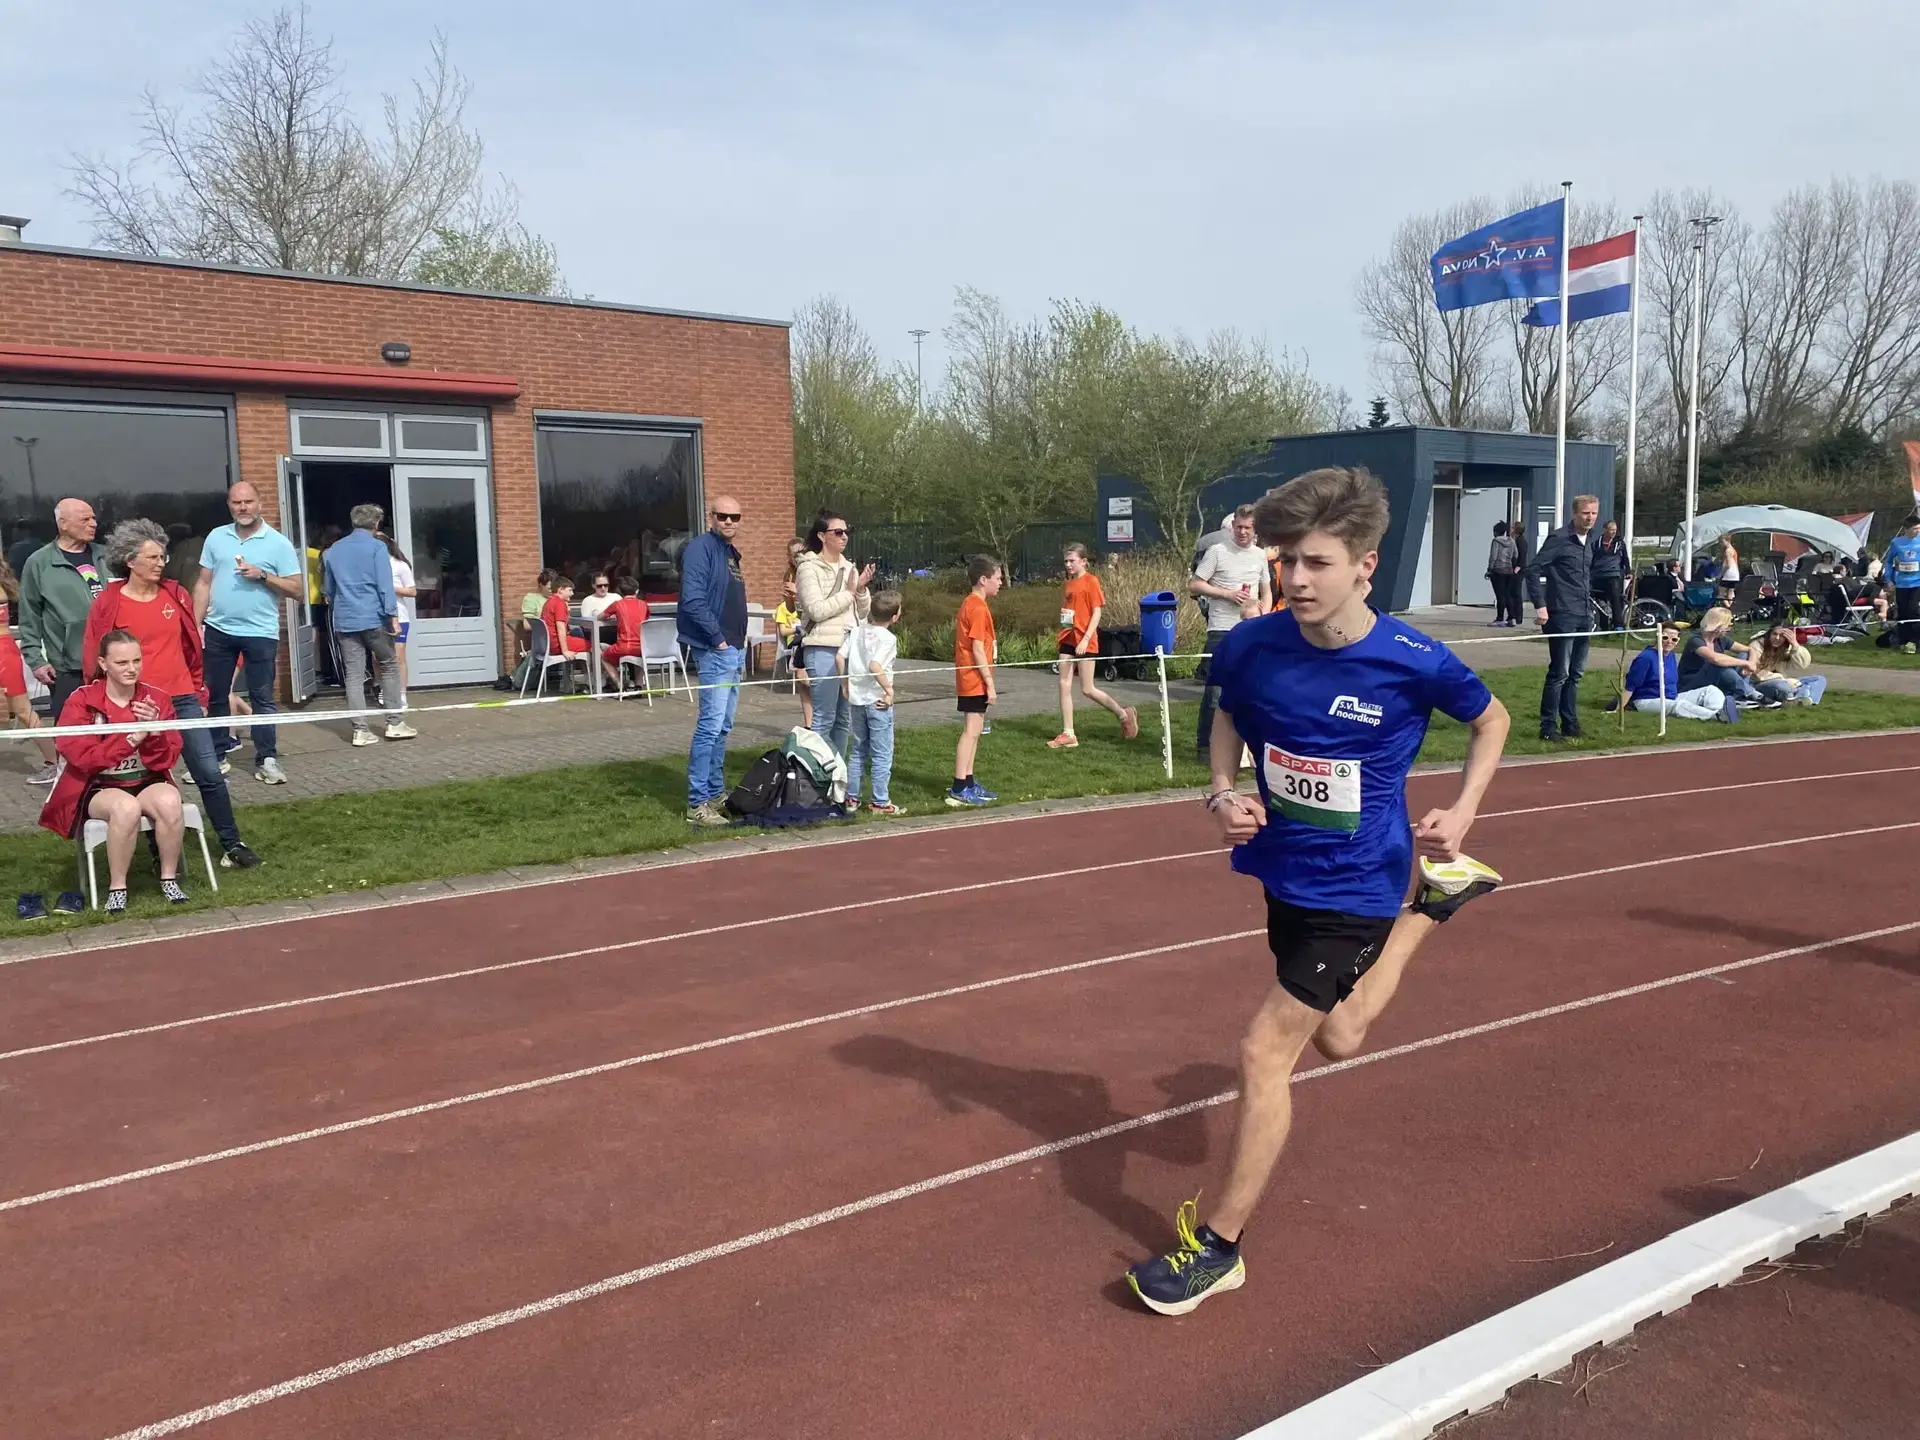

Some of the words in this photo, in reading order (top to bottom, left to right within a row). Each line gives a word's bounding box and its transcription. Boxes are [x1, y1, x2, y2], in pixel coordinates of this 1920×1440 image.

[1338, 701, 1354, 711] S.V.
[1336, 710, 1381, 727] noordkop
[1280, 755, 1330, 774] SPAR
[1284, 774, 1330, 803] 308
